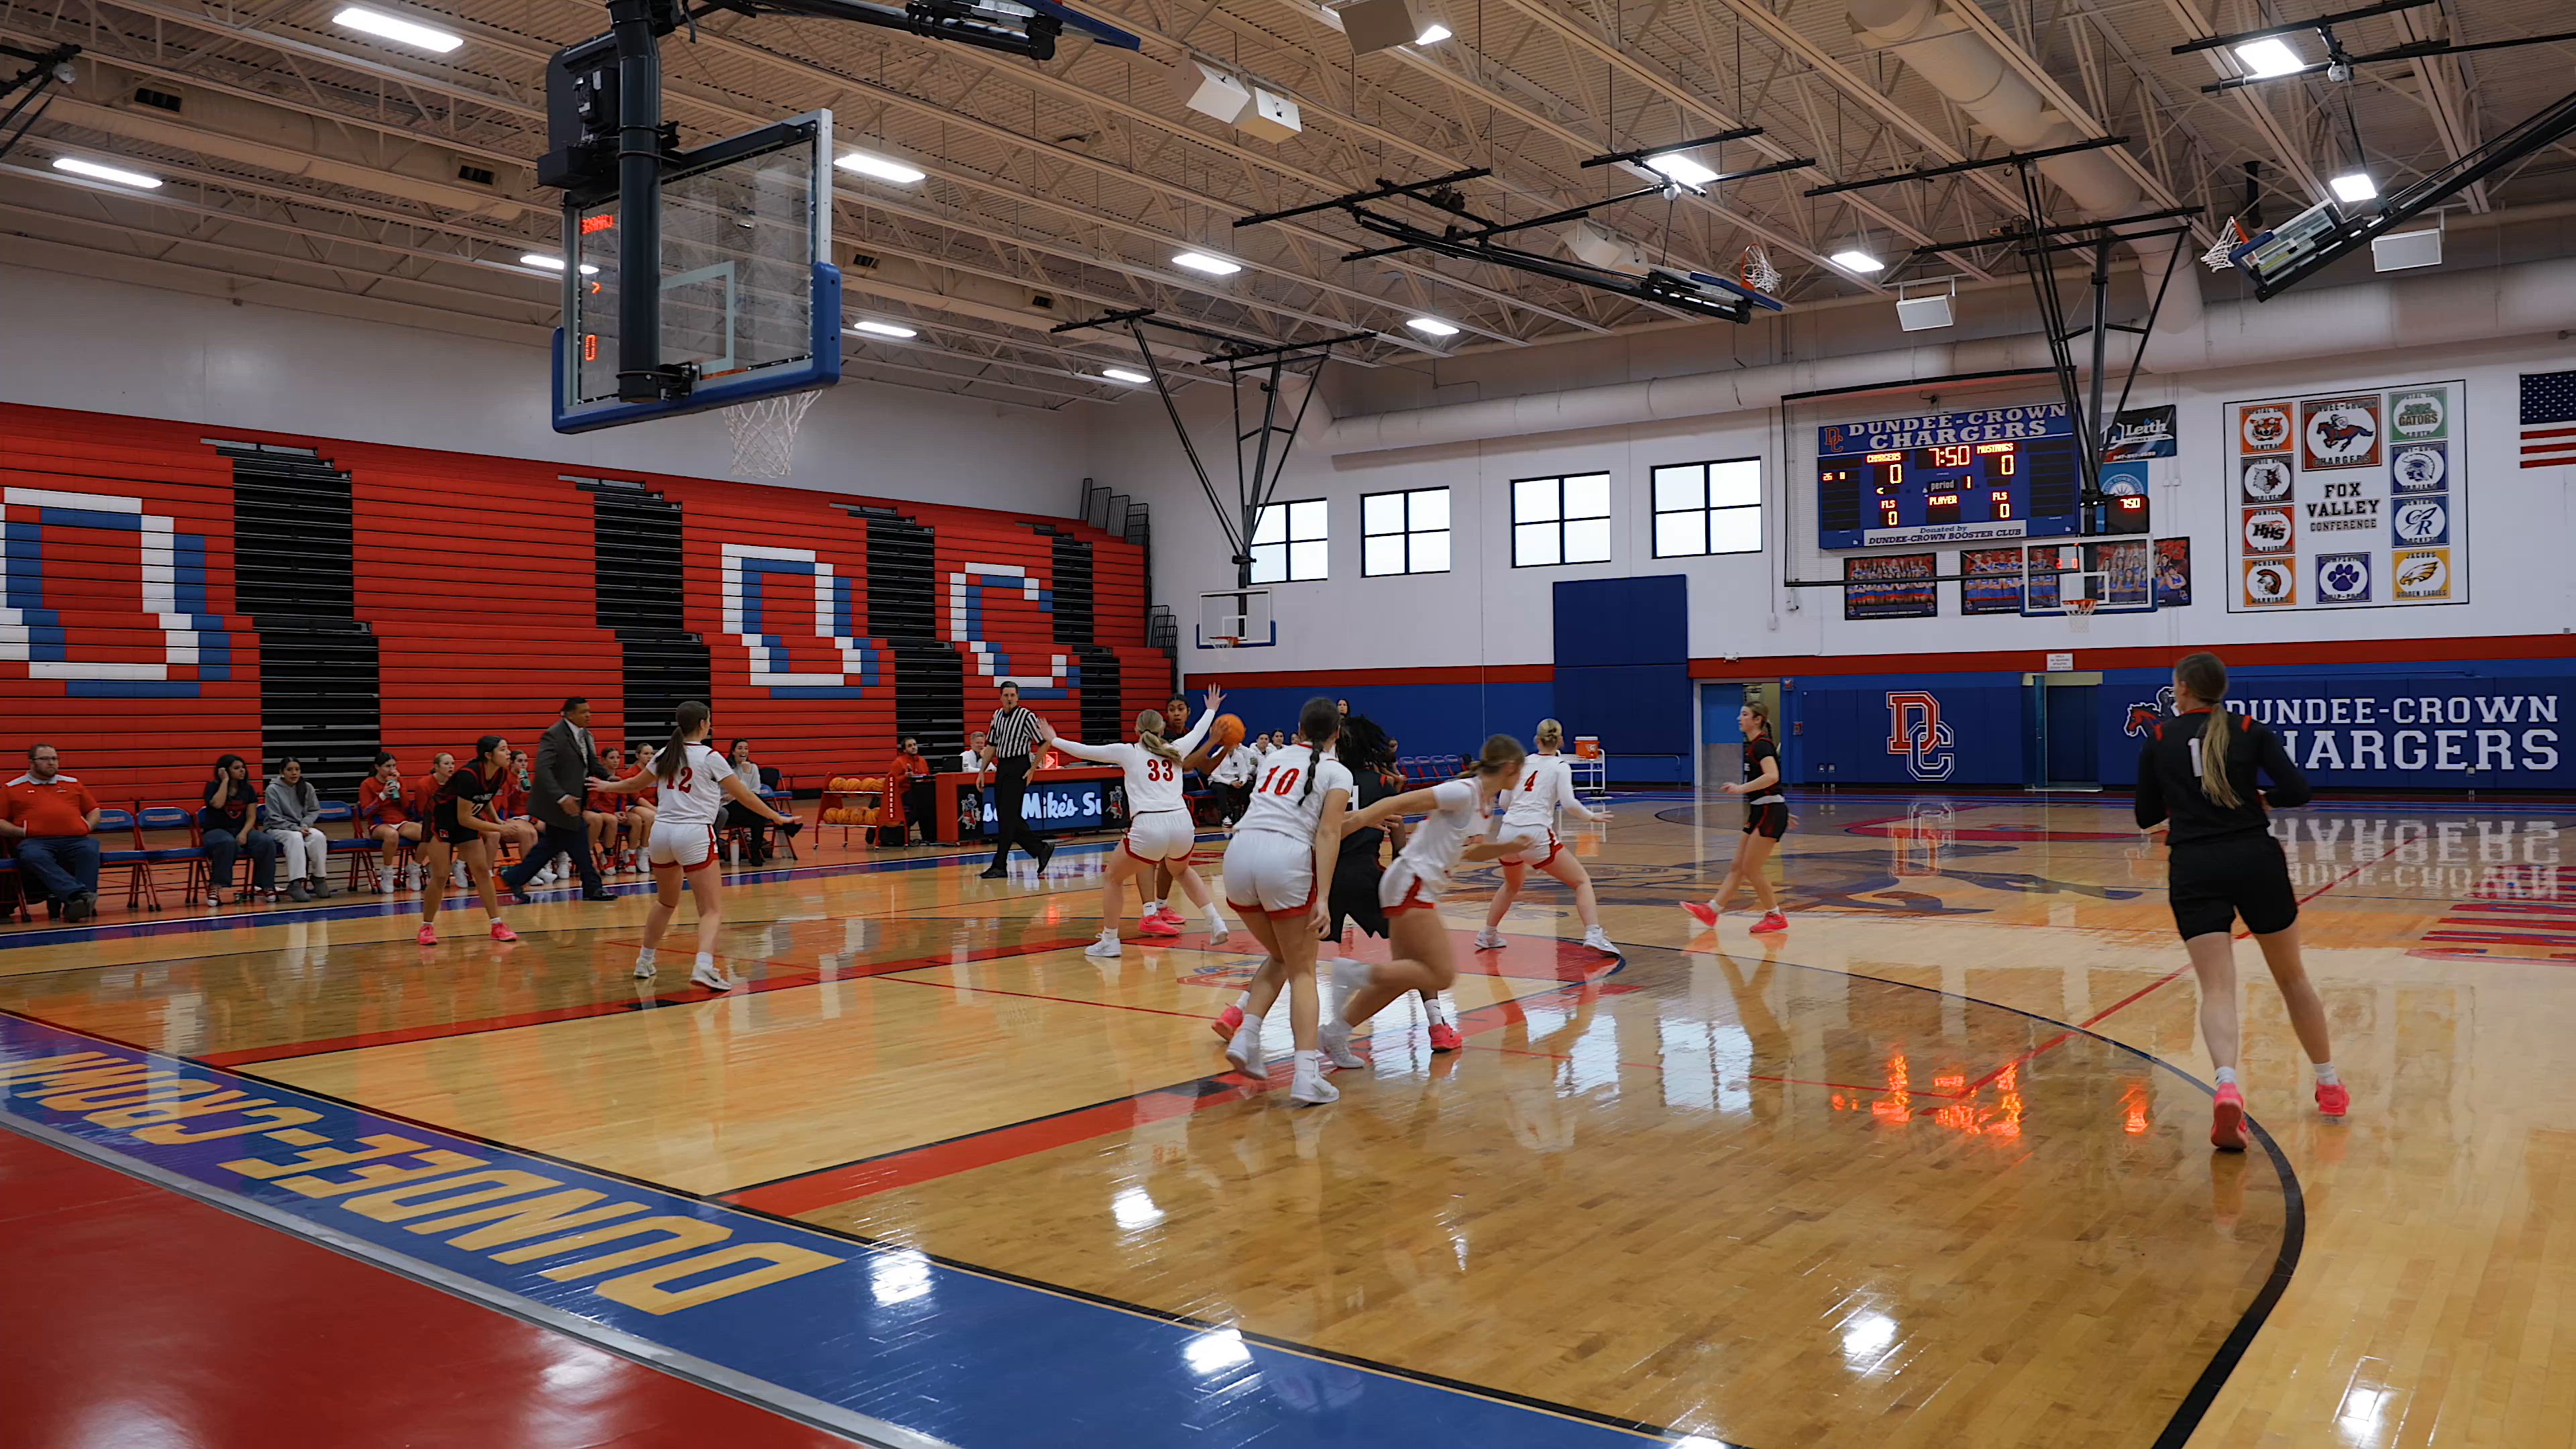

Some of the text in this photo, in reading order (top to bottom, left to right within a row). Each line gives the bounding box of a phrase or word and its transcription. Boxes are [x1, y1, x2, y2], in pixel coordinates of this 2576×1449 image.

[1849, 404, 2066, 436] DUNDEE-CROWN
[2399, 413, 2438, 427] GATORS
[1870, 420, 2046, 450] CHARGERS
[1929, 445, 1970, 466] 7:50
[2001, 454, 2015, 475] 0
[1889, 464, 1902, 484] 0
[1966, 476, 1971, 489] 1
[1931, 480, 1954, 491] period
[2325, 482, 2361, 498] FOX
[1881, 500, 1896, 508] FLS
[1929, 495, 1957, 506] PLAYER
[1992, 492, 2008, 500] FLS
[2000, 503, 2010, 518] 0
[2307, 499, 2379, 517] VALLEY
[1888, 511, 1898, 525] 0
[2310, 519, 2377, 532] CONFERENCE
[1869, 533, 1945, 545] DUNDEE-CROWN
[1948, 531, 1993, 539] BOOSTER
[1921, 526, 1954, 534] Donated
[2253, 523, 2286, 540] HHS
[1886, 691, 1954, 781] DC
[2274, 729, 2559, 771] ARGERS
[1148, 759, 1174, 782] 33
[666, 767, 692, 793] 12
[1258, 765, 1299, 796] 10
[1524, 770, 1538, 792] 4
[1021, 792, 1079, 820] Mike's
[0, 1051, 846, 1316] DUNDEE-CROWN
